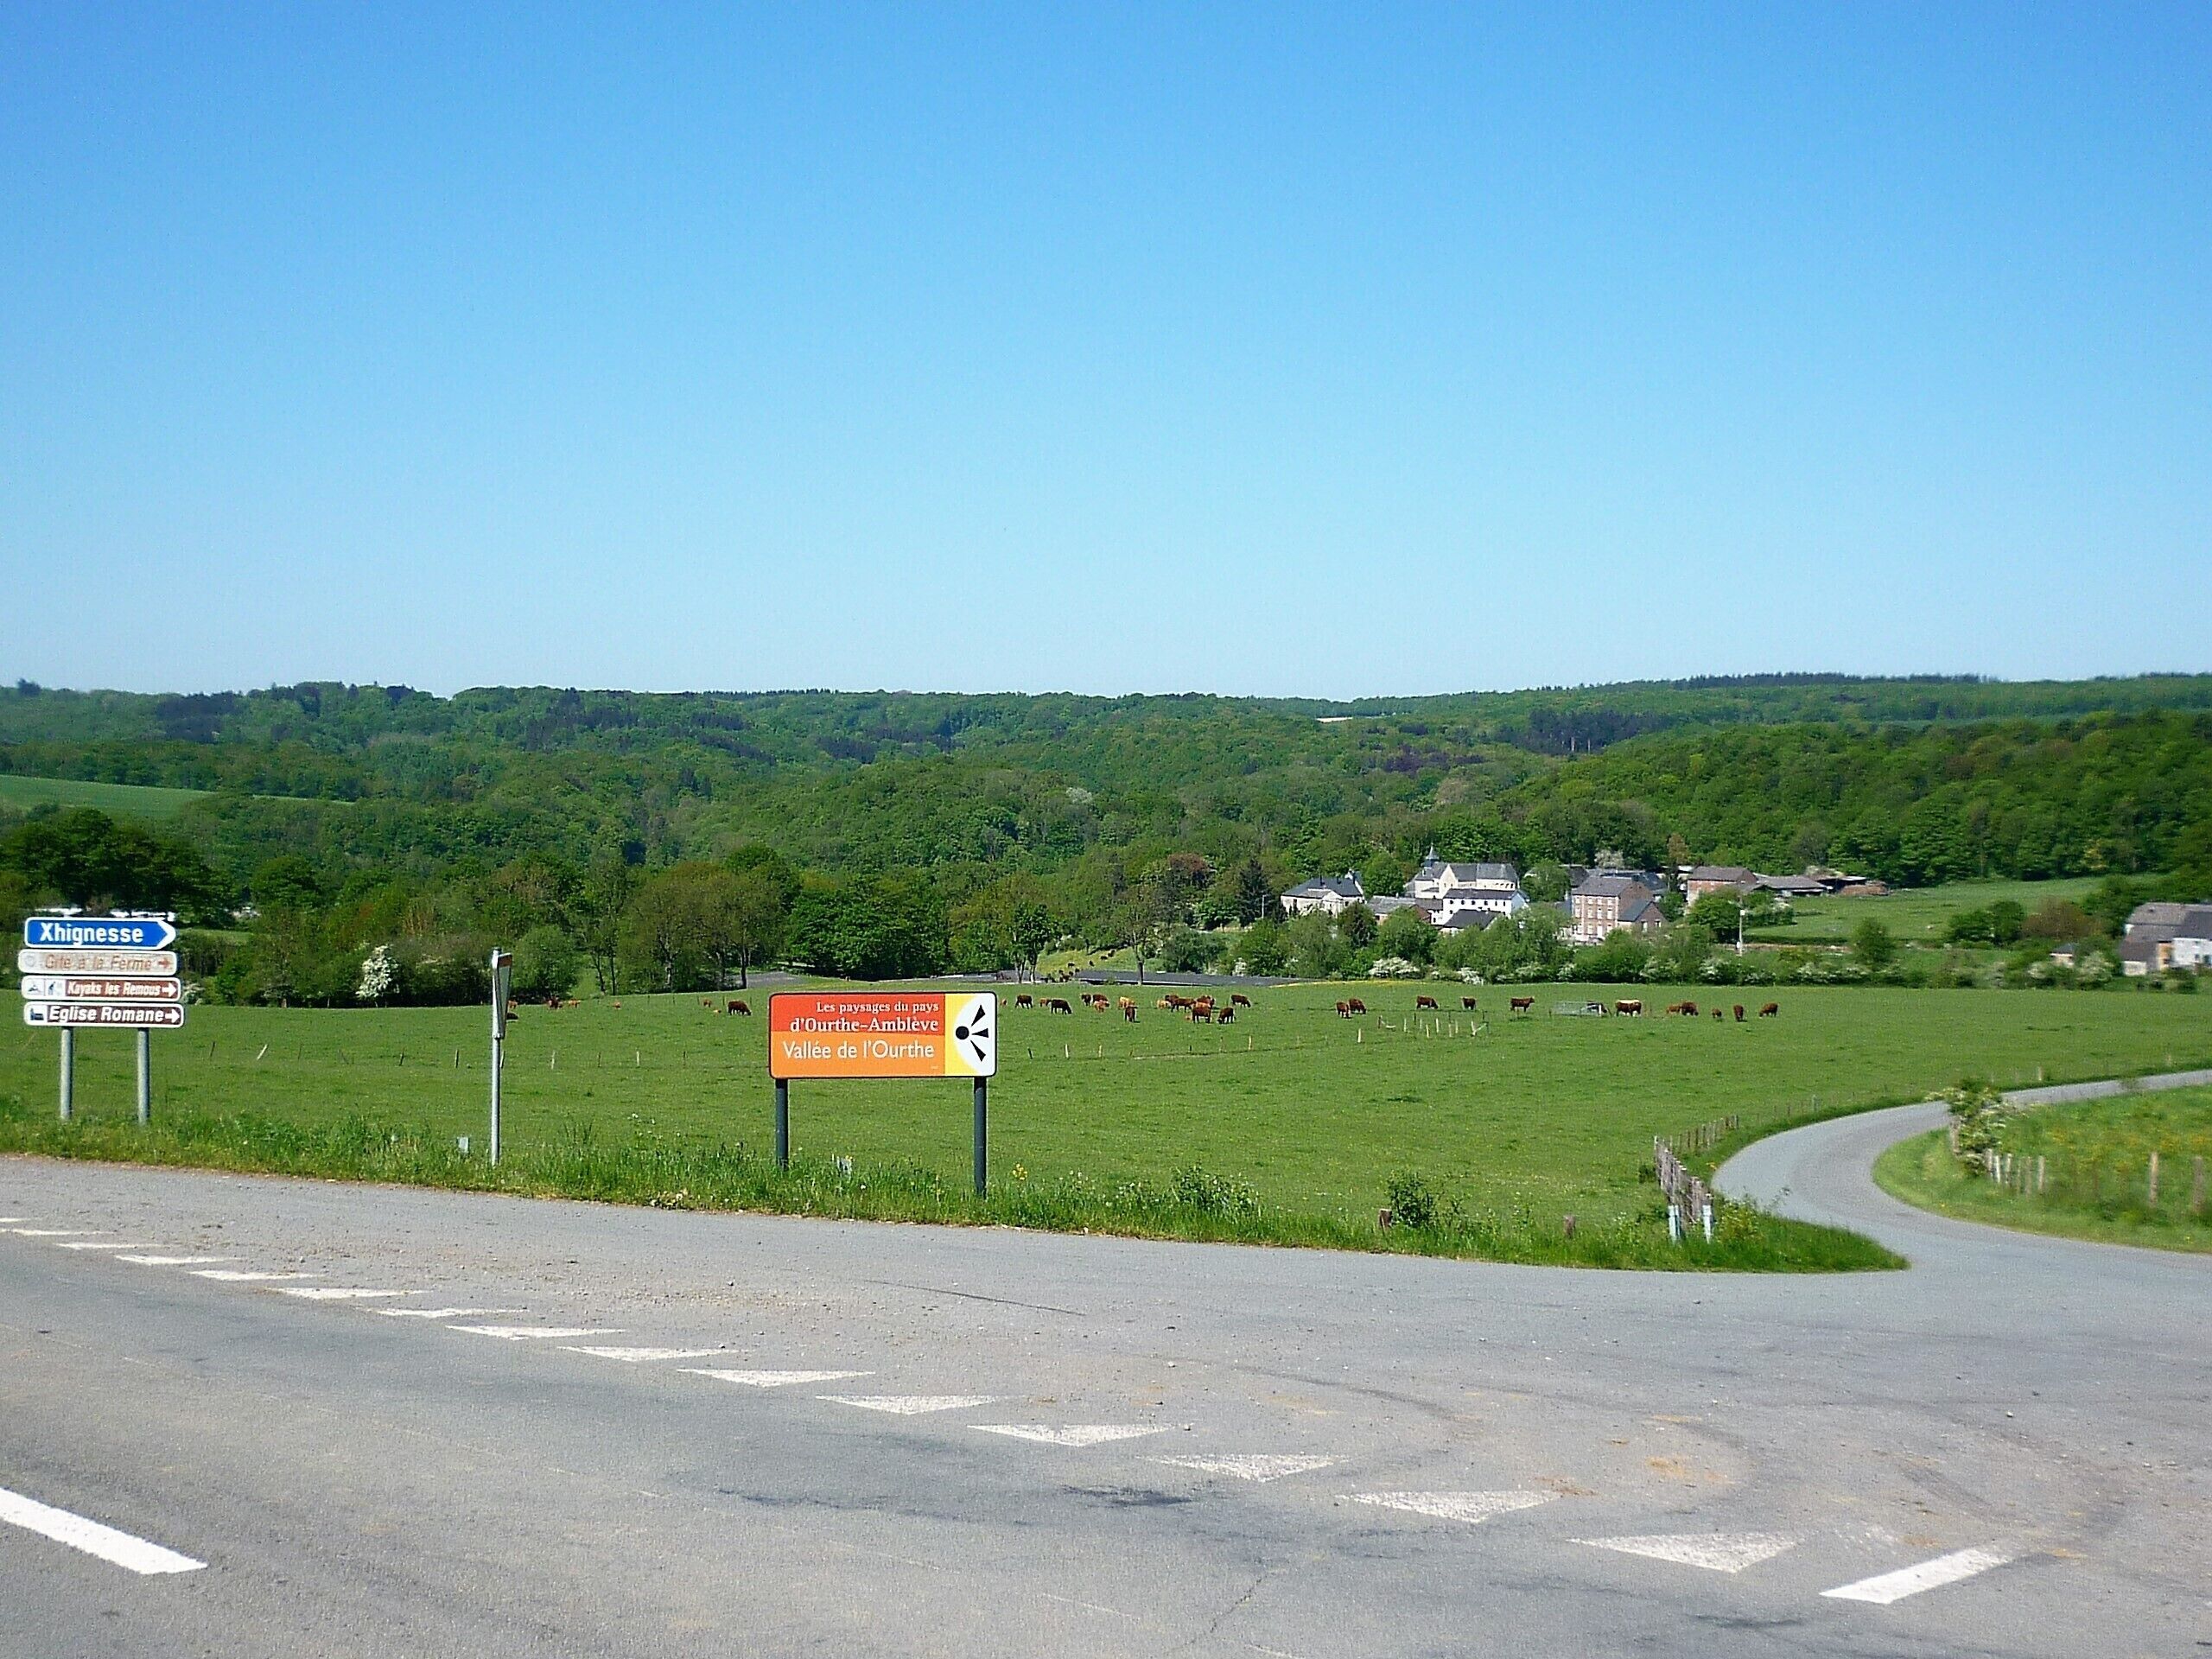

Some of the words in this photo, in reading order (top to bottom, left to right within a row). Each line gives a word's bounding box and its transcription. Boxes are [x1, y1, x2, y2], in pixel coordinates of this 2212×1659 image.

[40, 923, 143, 945] Xhignesse
[111, 956, 152, 969] Ferme
[67, 982, 101, 996] Kayaks
[105, 982, 119, 995] les
[124, 982, 160, 995] Remous
[49, 1006, 97, 1022] Eglise
[101, 1007, 163, 1021] Romane
[817, 1001, 835, 1012] Les
[839, 1002, 890, 1014] paysages
[894, 1001, 908, 1012] du
[912, 1003, 939, 1014] pays
[790, 1017, 938, 1032] d'Ourthe-Amblève
[783, 1040, 831, 1059] Vallée
[837, 1043, 857, 1058] de
[863, 1039, 934, 1058] l'Ourthe
